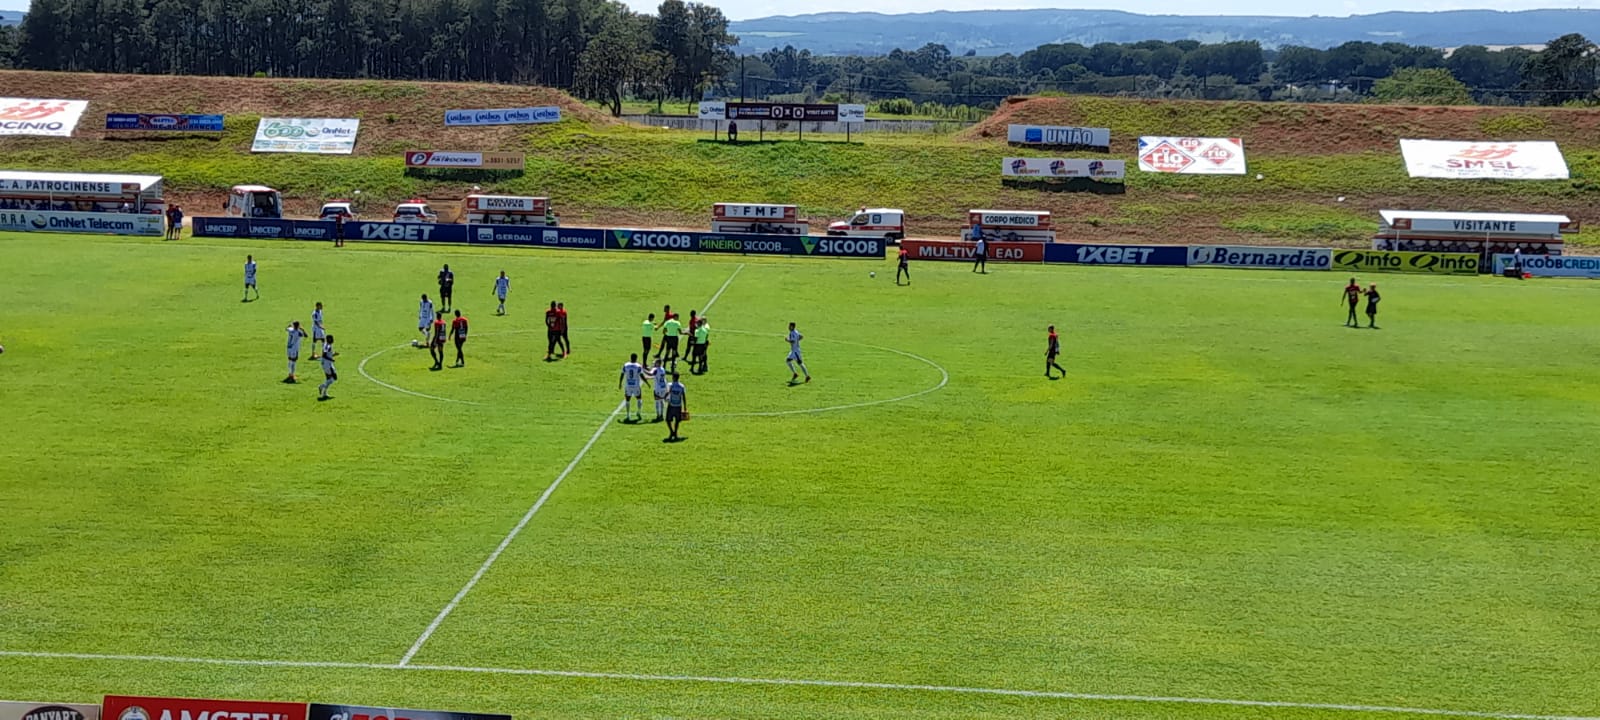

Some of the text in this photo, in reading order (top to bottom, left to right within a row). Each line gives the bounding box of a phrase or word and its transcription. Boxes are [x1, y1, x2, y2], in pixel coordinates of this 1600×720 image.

[1046, 128, 1094, 145] UNIÃO
[1152, 147, 1184, 163] rio
[1446, 159, 1519, 170] SMEL
[12, 180, 23, 189] A.
[26, 180, 111, 192] PATROCINENSE
[49, 216, 86, 229] OnNet
[87, 217, 134, 230] Telecom
[985, 215, 1008, 224] CORPO
[1453, 221, 1516, 231] VISITANTE
[205, 225, 238, 233] UNICERP
[249, 226, 282, 235] UNICERP
[293, 227, 326, 236] UNICERP
[359, 224, 435, 240] 1XBET
[496, 233, 532, 241] GERDAU
[560, 236, 596, 244] GERDAU
[633, 233, 692, 249] SICOOB
[699, 239, 782, 252] MINEIRO SICOOB
[819, 239, 878, 254] SICOOB
[919, 246, 1024, 259] MULTIV EAD
[1076, 246, 1155, 264] 1XBET
[1212, 247, 1329, 267] Bernardão
[1522, 257, 1600, 270] ICOOBCREDI
